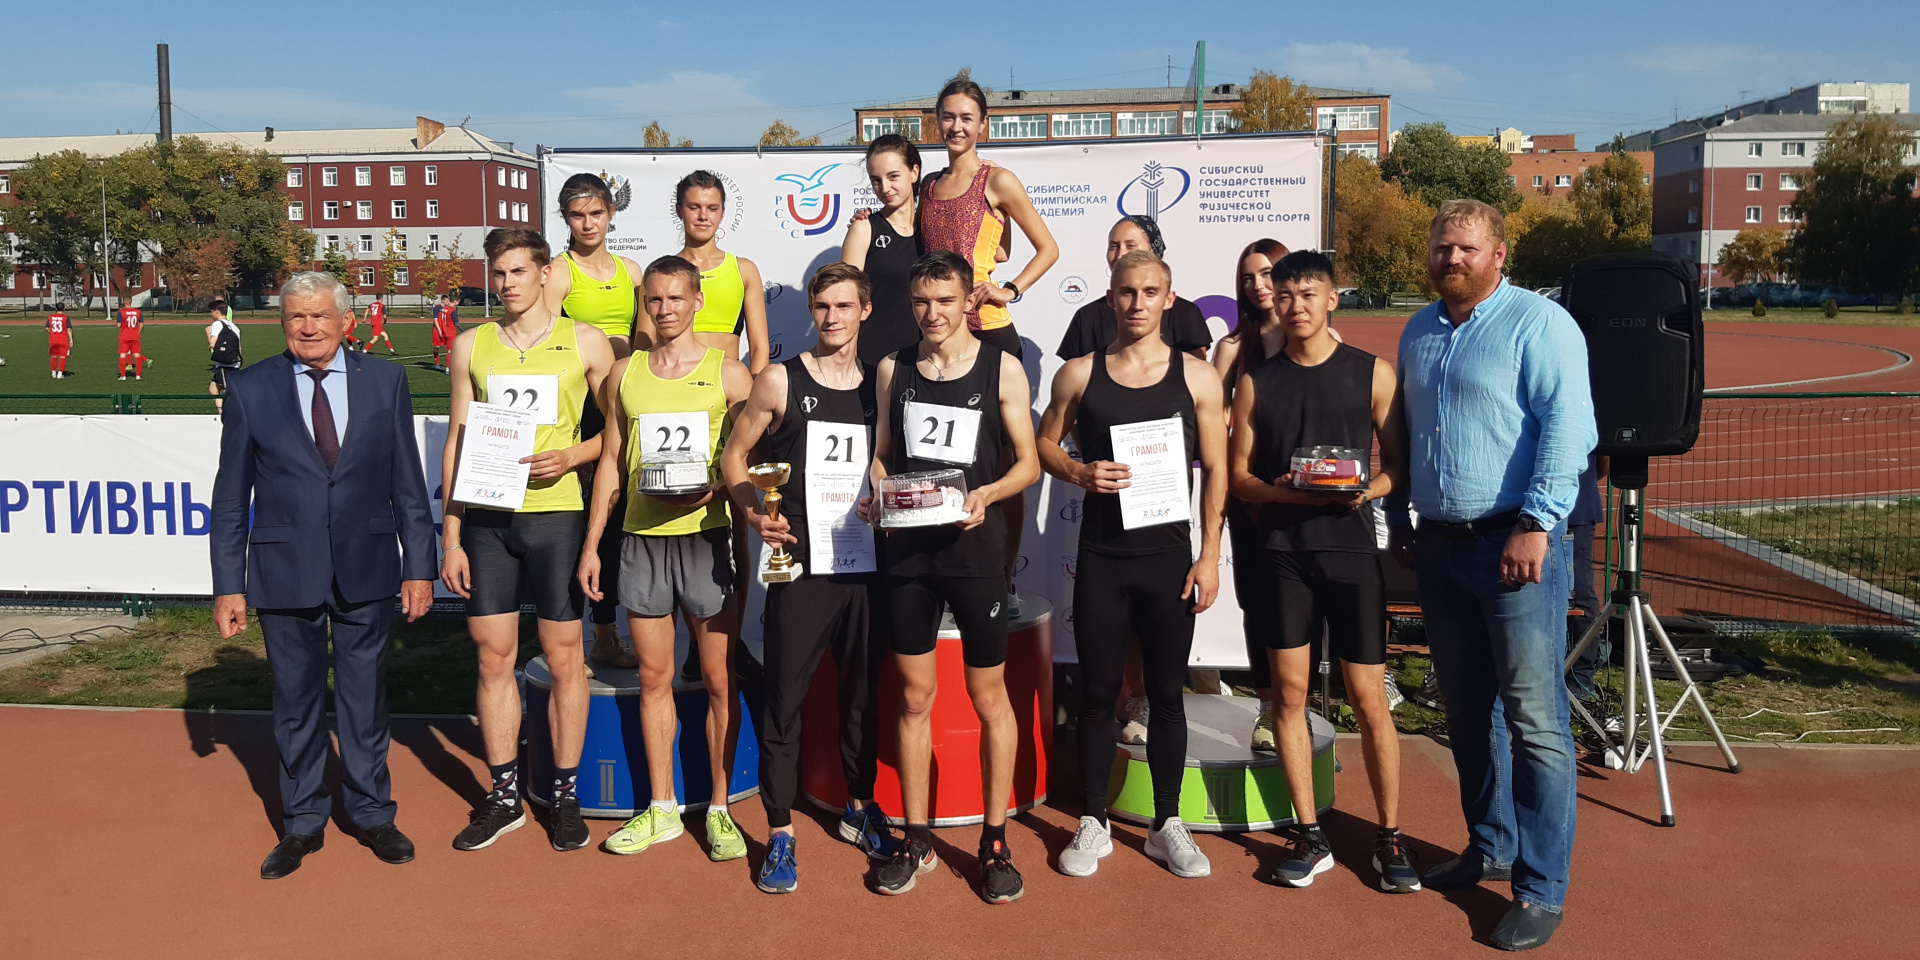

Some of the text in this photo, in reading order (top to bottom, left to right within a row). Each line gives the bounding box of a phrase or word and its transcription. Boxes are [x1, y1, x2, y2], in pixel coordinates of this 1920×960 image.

[1199, 164, 1264, 175] СИБИРСКИЙ
[1199, 176, 1306, 187] ГОСУДАРСТВЕННЫЙ
[1026, 184, 1091, 194] СИБИРСКАЯ
[1199, 189, 1271, 199] УНИВЕРСИТЕТ
[1199, 201, 1272, 211] ФИЗИЧЕСКОЙ
[729, 195, 744, 232] РОССИИ
[1199, 213, 1310, 223] КУЛЬТУРЫ И СПОРТА
[51, 320, 63, 333] 33
[126, 315, 138, 328] 10
[1610, 317, 1647, 328] EON
[503, 388, 540, 411] 22
[482, 424, 519, 440] ГРАМОТА
[656, 425, 692, 452] 22
[918, 416, 956, 448] 21
[824, 434, 855, 462] 21
[1130, 442, 1168, 457] ГРАМОТА
[821, 492, 855, 503] ГРАМОТА
